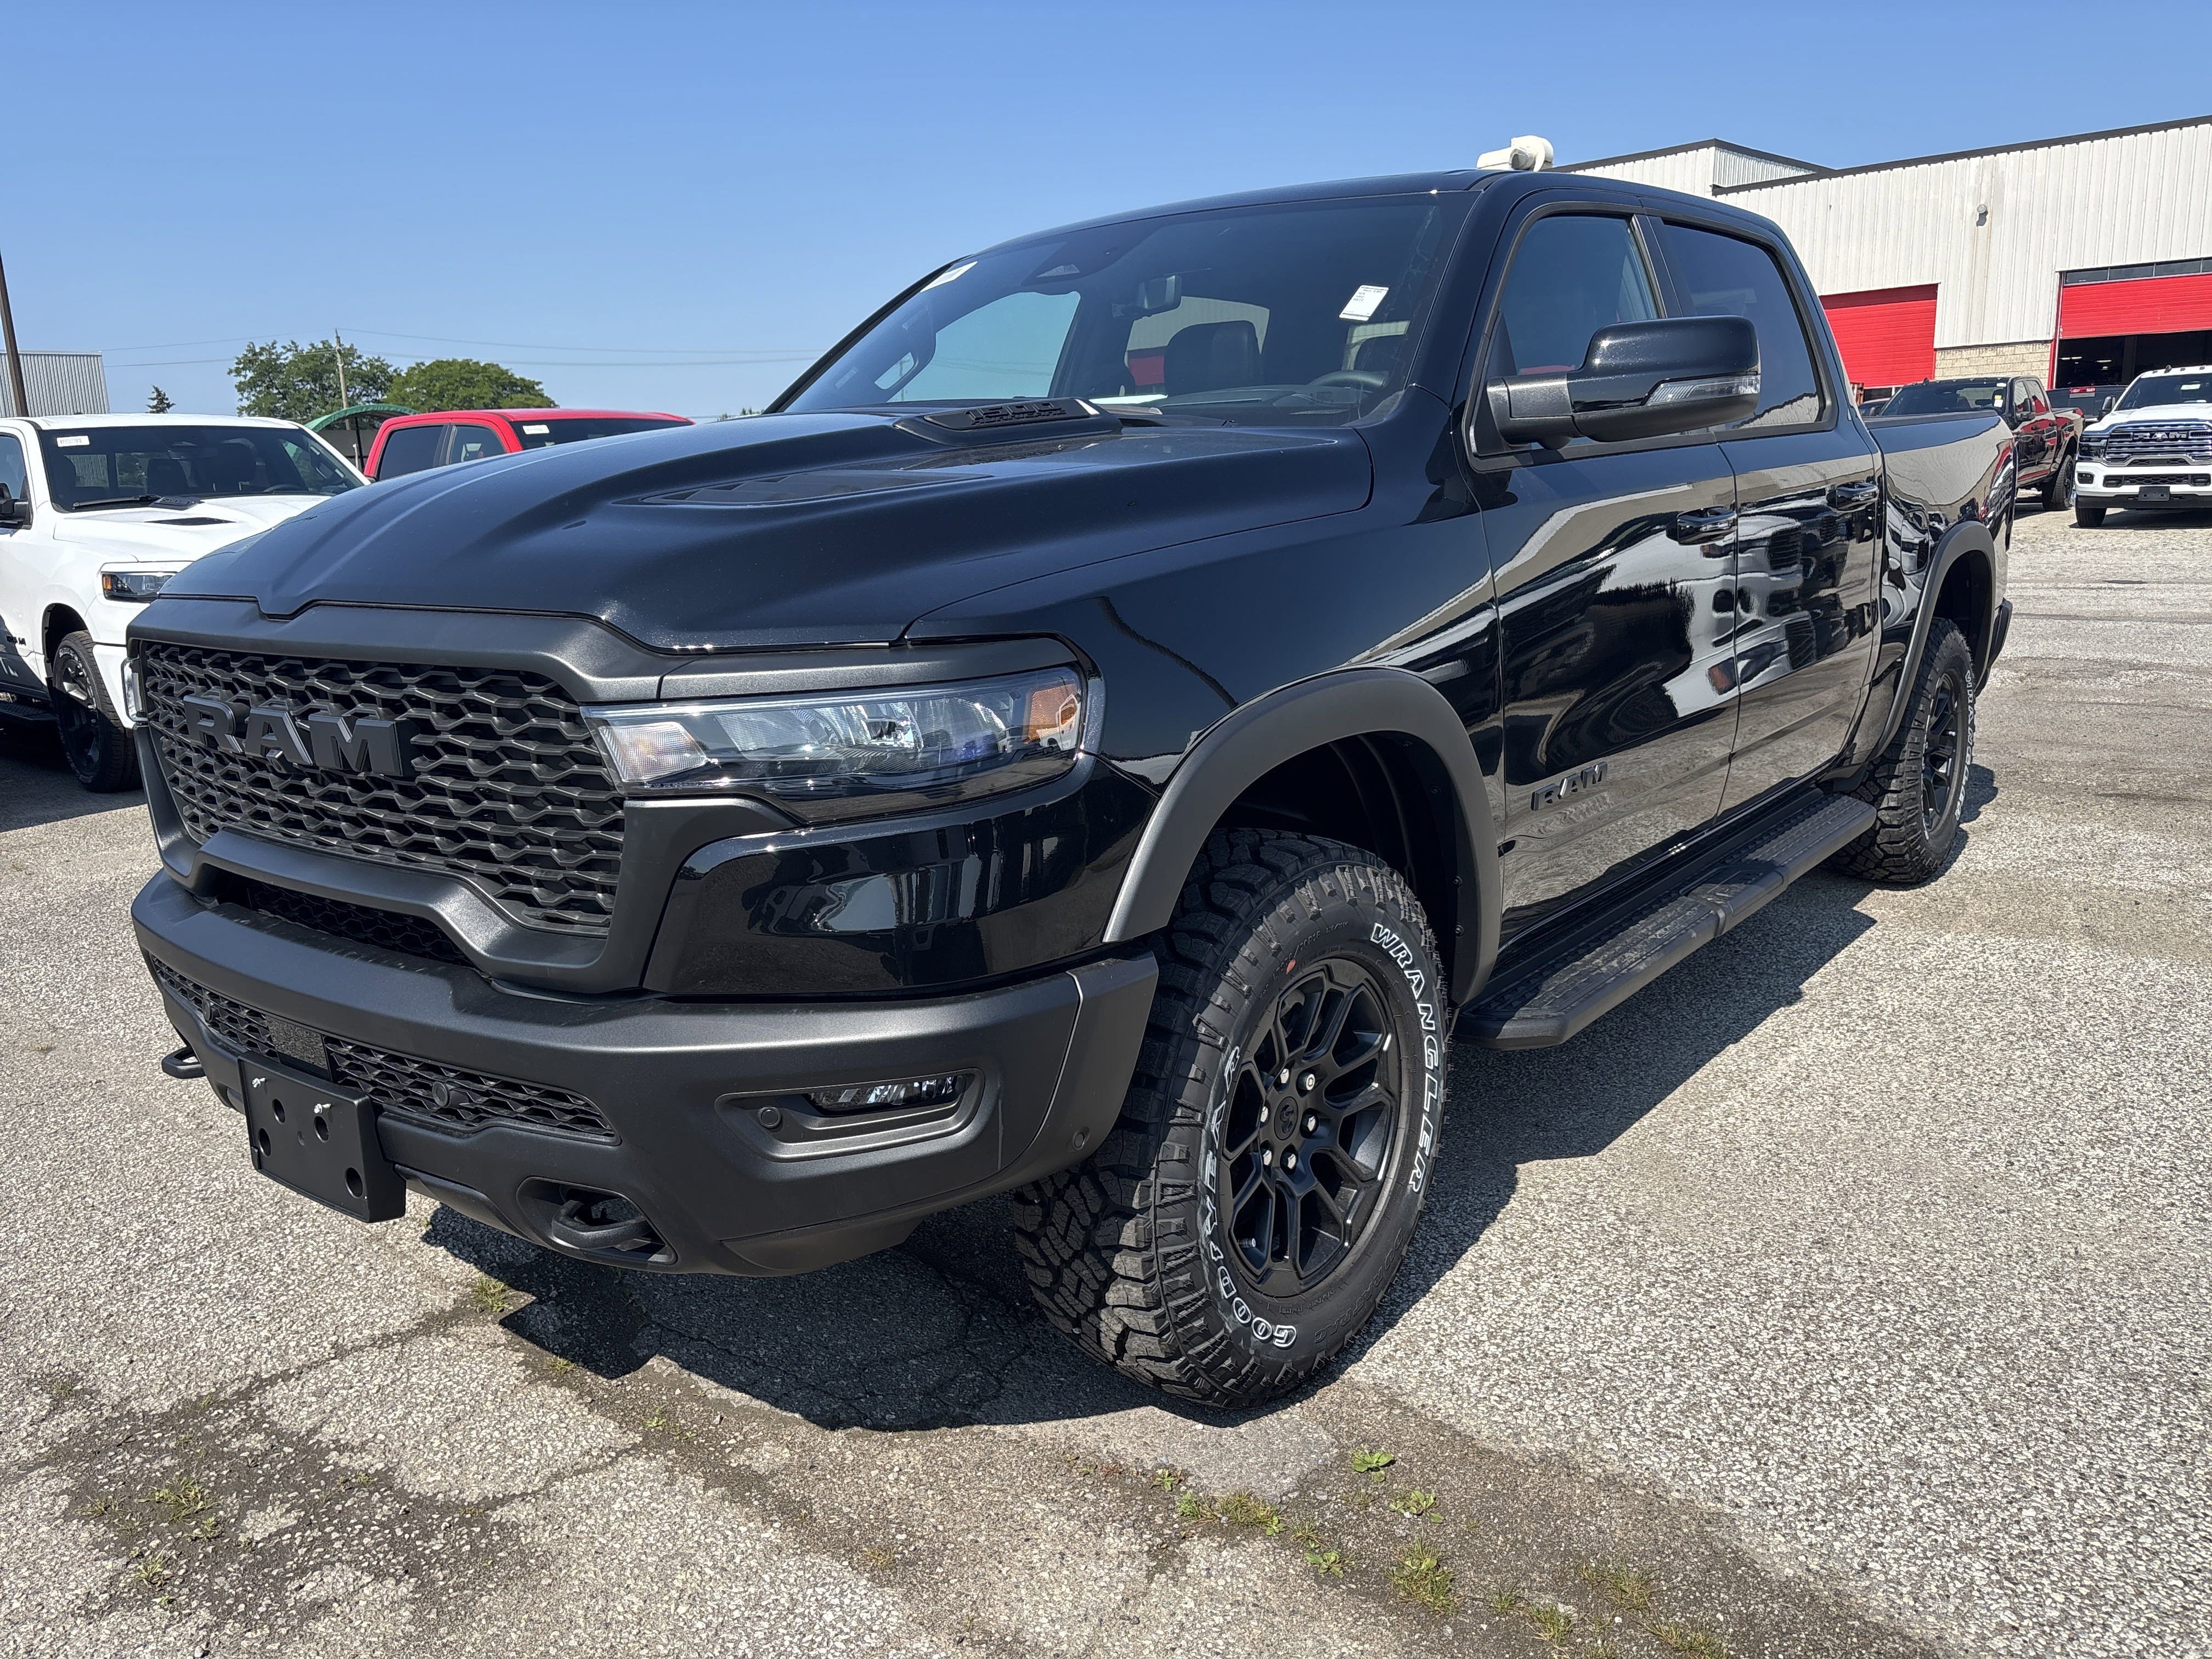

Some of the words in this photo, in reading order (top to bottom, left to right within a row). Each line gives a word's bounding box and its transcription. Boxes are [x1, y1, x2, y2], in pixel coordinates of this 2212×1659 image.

[2133, 431, 2188, 440] RAM
[183, 695, 403, 777] RAM
[1530, 761, 1608, 811] RAM
[1370, 922, 1438, 1192] WRANGLER
[1204, 1045, 1297, 1347] GOODYEAR
